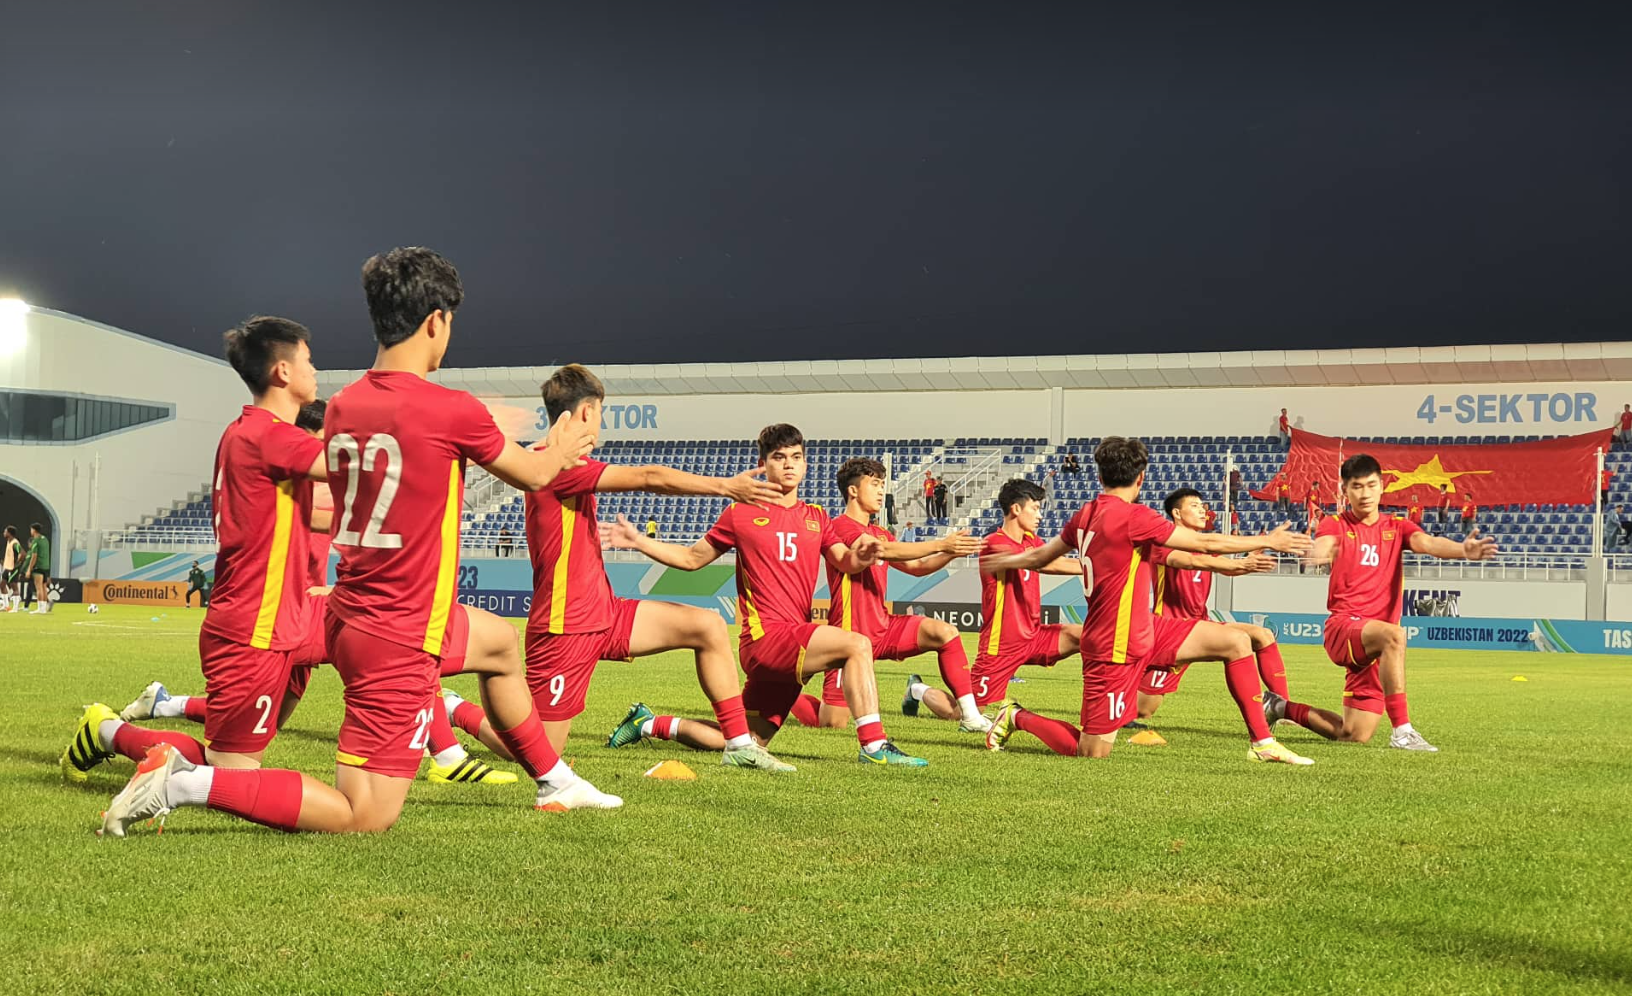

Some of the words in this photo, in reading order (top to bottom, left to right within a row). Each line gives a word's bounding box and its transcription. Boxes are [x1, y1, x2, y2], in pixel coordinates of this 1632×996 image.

[1416, 392, 1598, 424] 4-SEKTOR
[327, 433, 403, 549] 22
[776, 531, 798, 562] 15
[1360, 543, 1380, 567] 26
[103, 583, 169, 602] Continental
[456, 594, 516, 612] CREDIT
[1290, 623, 1322, 637] U23
[1427, 627, 1494, 642] UZBEKISTAN
[1497, 629, 1529, 642] 2022
[549, 674, 565, 706] 9
[976, 676, 990, 697] 5
[1150, 669, 1168, 688] 12
[252, 694, 272, 734] 2
[1106, 691, 1126, 721] 16
